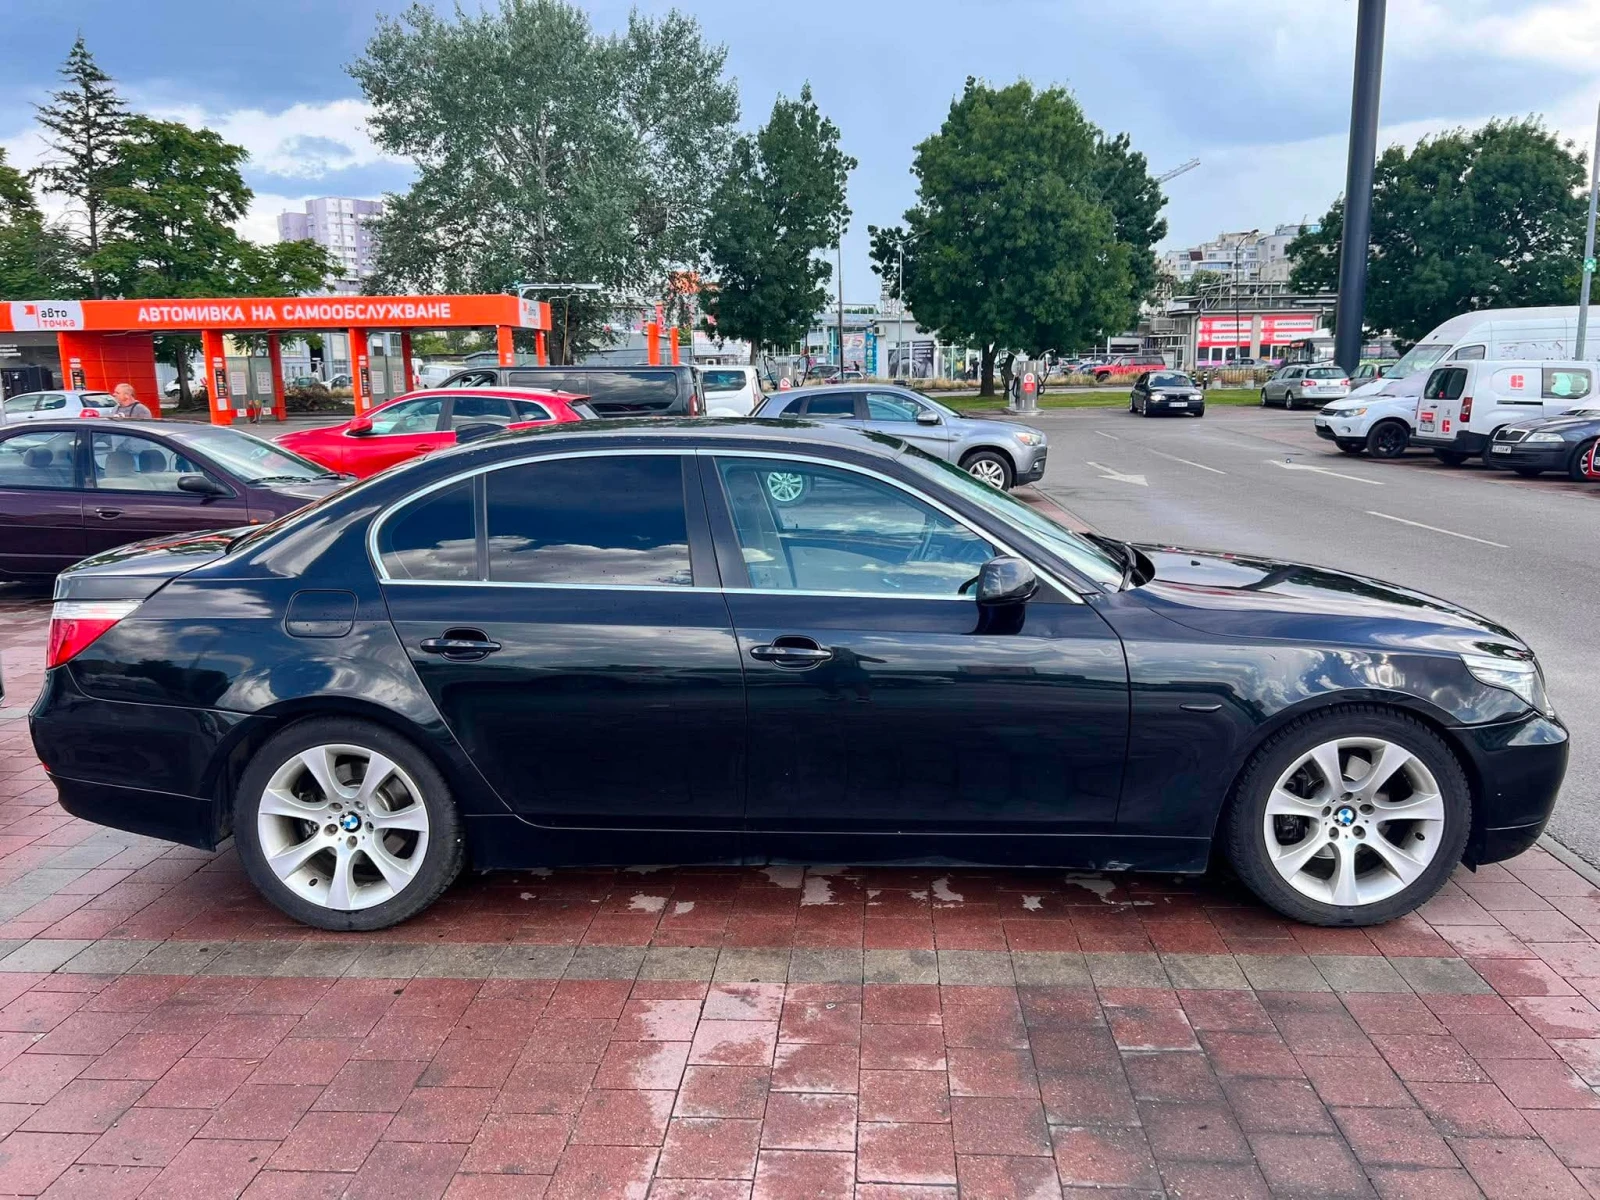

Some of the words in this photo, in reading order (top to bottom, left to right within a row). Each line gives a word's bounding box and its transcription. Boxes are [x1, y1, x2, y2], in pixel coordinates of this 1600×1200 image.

[138, 306, 245, 322] АВТОМИВКА
[252, 306, 276, 320] НА
[283, 303, 451, 320] САМООБСЛУЖВАНЕ
[42, 320, 75, 328] точка
